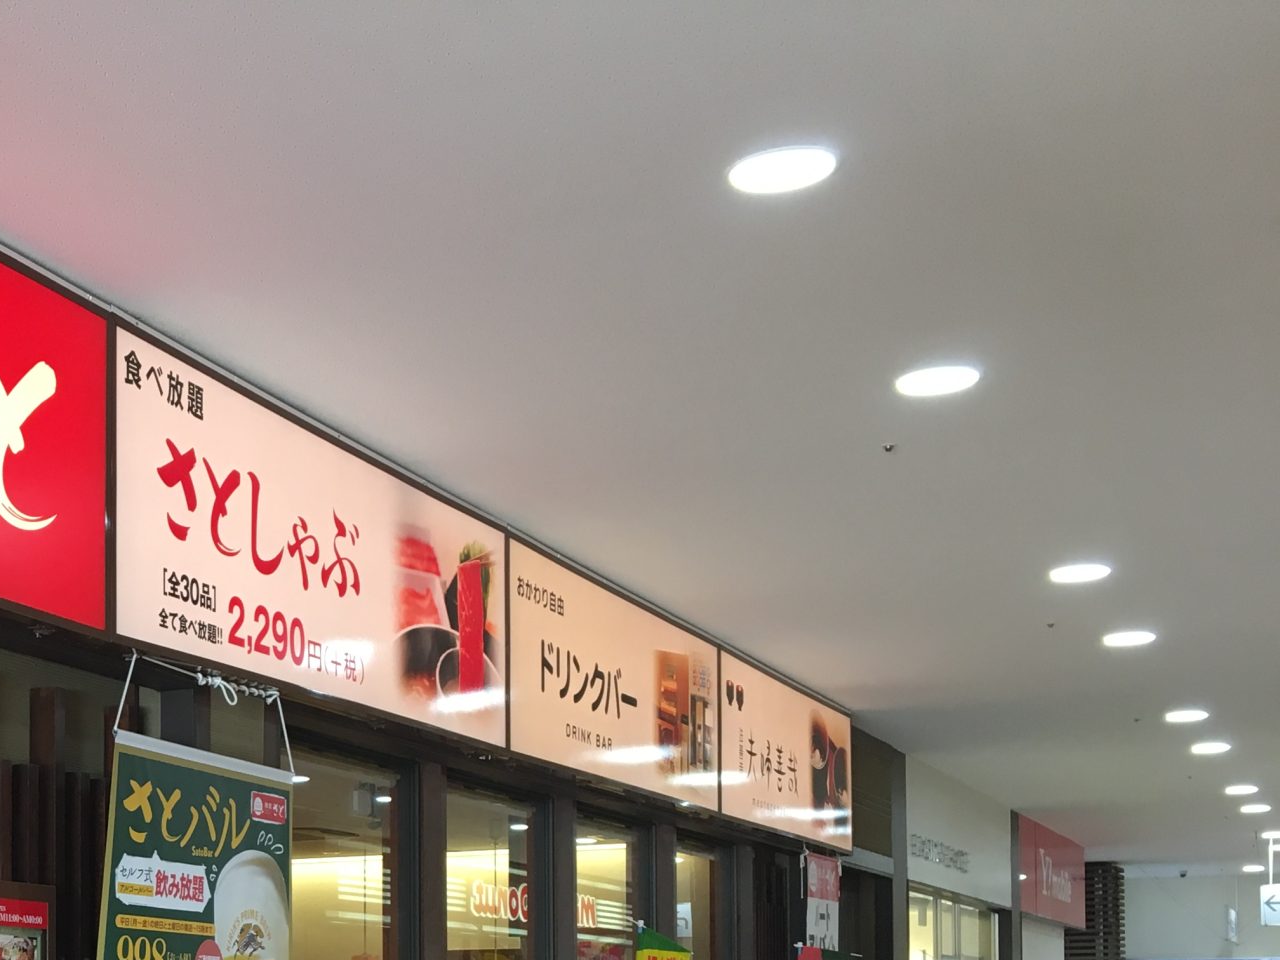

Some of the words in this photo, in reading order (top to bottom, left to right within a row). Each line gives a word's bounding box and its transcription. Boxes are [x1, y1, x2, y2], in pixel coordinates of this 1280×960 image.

[123, 349, 205, 422] 食べ放題
[156, 438, 362, 598] さとしゃぶ
[516, 575, 565, 617] おかわり自由
[540, 638, 638, 720] ドリンクバー
[565, 722, 592, 746] DRINK
[595, 733, 613, 752] BAR
[122, 778, 251, 858] さとバル
[120, 866, 153, 883] セルフ式
[154, 869, 205, 903] 飲み放題
